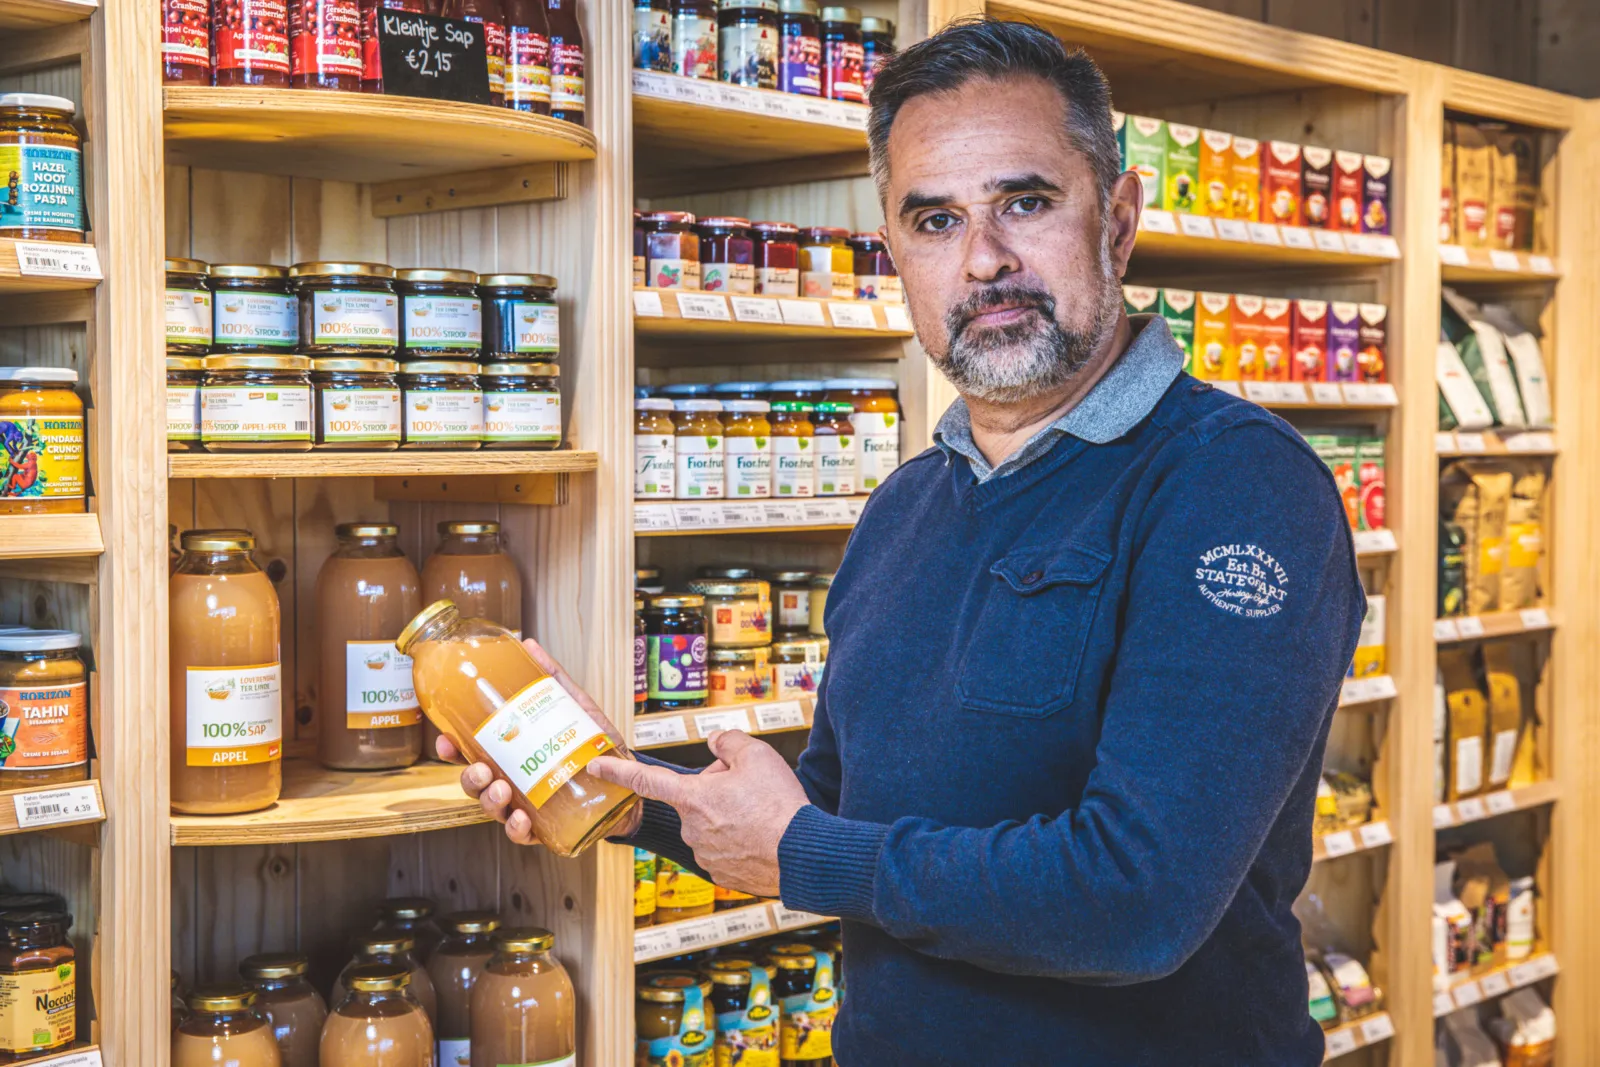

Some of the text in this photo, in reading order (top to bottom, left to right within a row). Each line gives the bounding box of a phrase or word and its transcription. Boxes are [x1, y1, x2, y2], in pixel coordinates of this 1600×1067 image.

[383, 15, 440, 49] Kleintje
[444, 22, 474, 49] Sap
[405, 48, 453, 78] €2,15
[32, 161, 67, 173] HAZEL
[34, 172, 66, 184] NOOT
[22, 183, 75, 195] ROZIJNEN
[34, 194, 68, 205] PASTA
[63, 263, 69, 271] €
[166, 325, 186, 333] ROOP
[221, 323, 254, 335] 100%
[254, 327, 280, 337] STROOP
[320, 322, 352, 334] 100%
[353, 326, 380, 335] STROOP
[411, 326, 443, 338] 100%
[443, 330, 467, 338] STROOP
[520, 332, 547, 344] 100%
[214, 423, 240, 431] STROOP
[242, 423, 287, 431] APPEL-PEER
[329, 420, 388, 432] 100% STROOP
[412, 421, 469, 432] 100% STROOP
[485, 421, 540, 432] 100% STROOP
[1195, 567, 1248, 587] STATE
[1257, 581, 1288, 602] ART
[1198, 583, 1282, 618] AUTHENTIC SUPPLIER
[19, 690, 72, 701] HORIZON
[361, 688, 400, 704] 100%
[22, 704, 69, 719] TAHIN
[370, 714, 401, 726] APPEL
[202, 720, 267, 738] 100% SAP
[212, 751, 249, 763] APPEL
[519, 728, 577, 776] 100% SAP
[547, 760, 580, 790] APPEL
[63, 803, 91, 815] € 4.39
